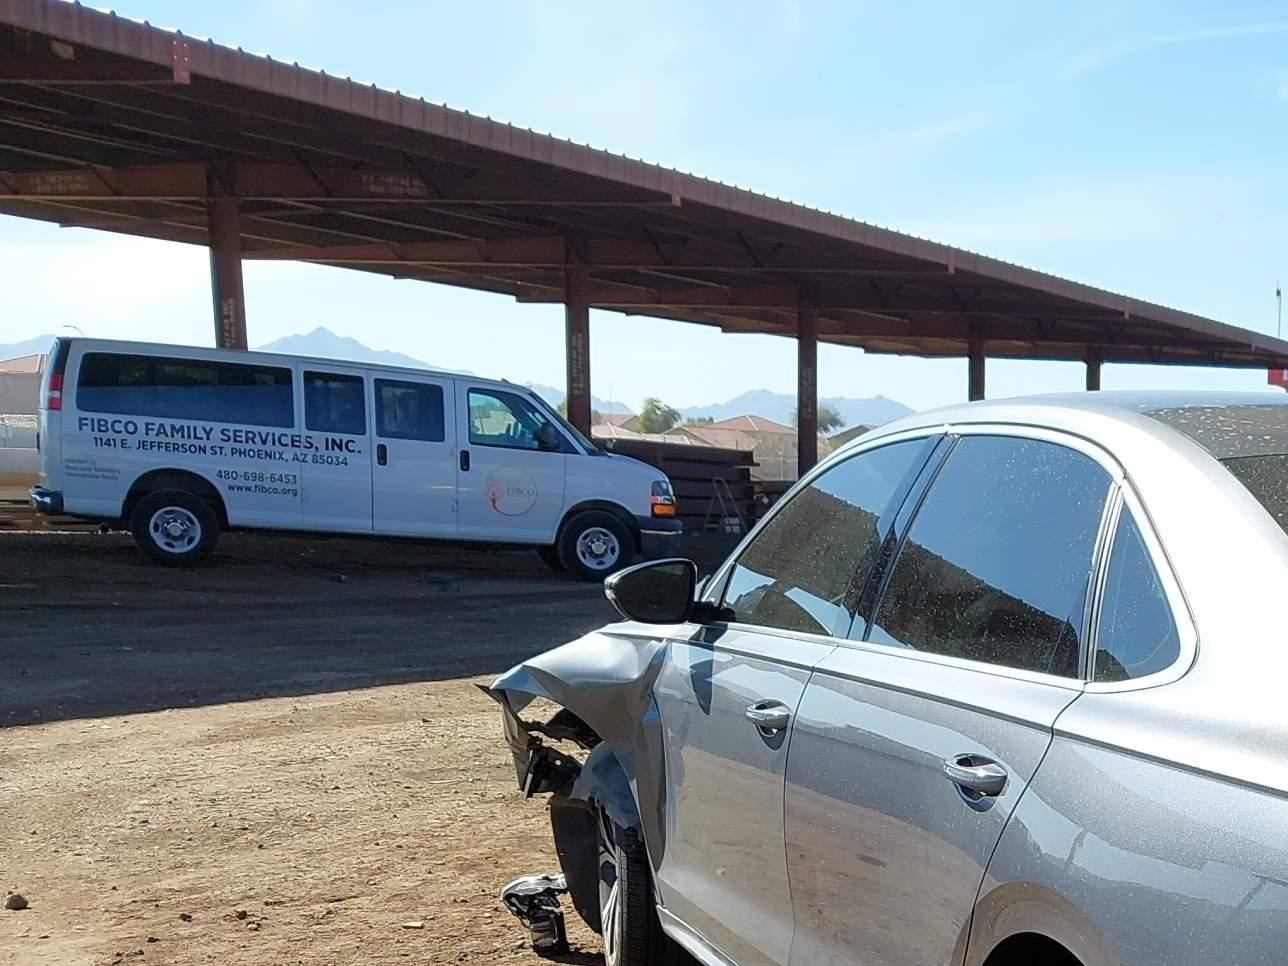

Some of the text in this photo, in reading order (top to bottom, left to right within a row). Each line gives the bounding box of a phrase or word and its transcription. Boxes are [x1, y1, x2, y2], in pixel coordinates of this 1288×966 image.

[77, 416, 362, 454] FIBCO FAMILY SERVICES, INC.
[93, 436, 349, 467] 1141 E. JEFFERSON ST. PHOENIX, AZ 85034
[215, 469, 297, 485] 480-698-6453
[227, 482, 298, 498] www.fibco.org
